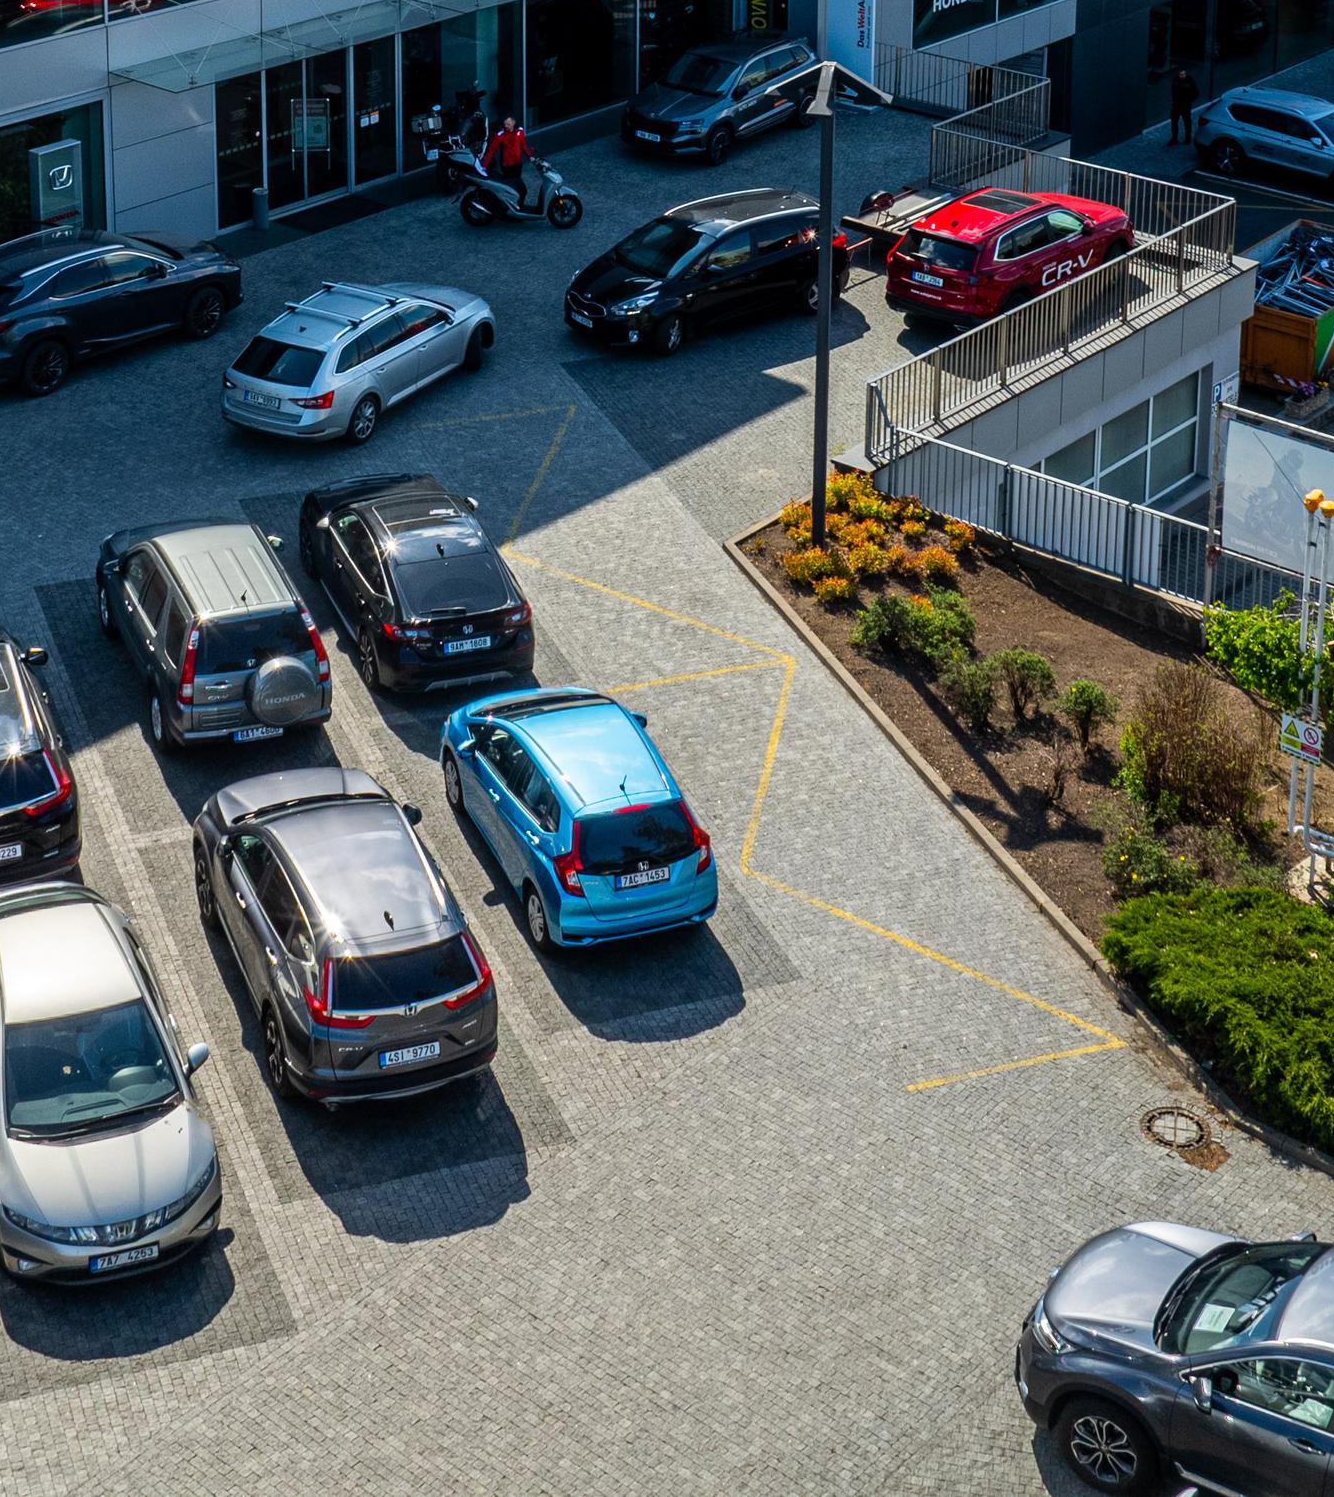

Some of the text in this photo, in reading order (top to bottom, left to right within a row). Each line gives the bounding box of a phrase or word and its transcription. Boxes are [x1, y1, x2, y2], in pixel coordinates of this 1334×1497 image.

[1041, 249, 1094, 287] CR-V
[264, 692, 306, 706] HONDA
[623, 868, 666, 887] 7AC 1453
[412, 1043, 435, 1058] 9770
